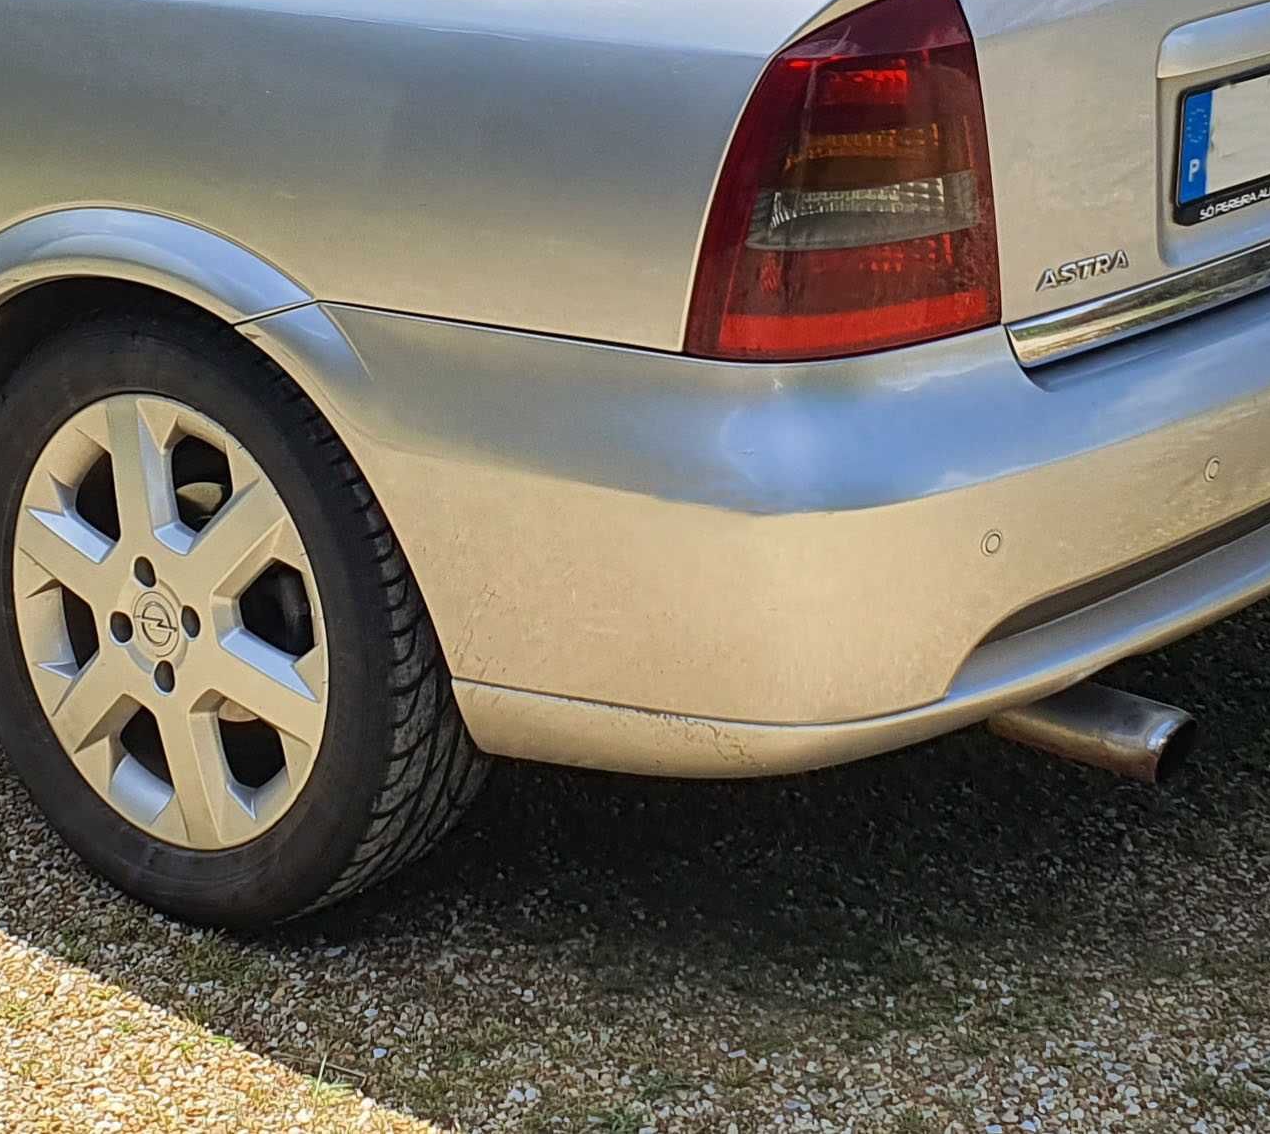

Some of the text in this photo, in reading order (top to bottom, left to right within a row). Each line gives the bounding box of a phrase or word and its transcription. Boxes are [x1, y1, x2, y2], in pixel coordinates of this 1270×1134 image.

[1188, 158, 1200, 182] P
[1215, 191, 1257, 215] PEREIRA
[1035, 250, 1129, 292] ASTRA
